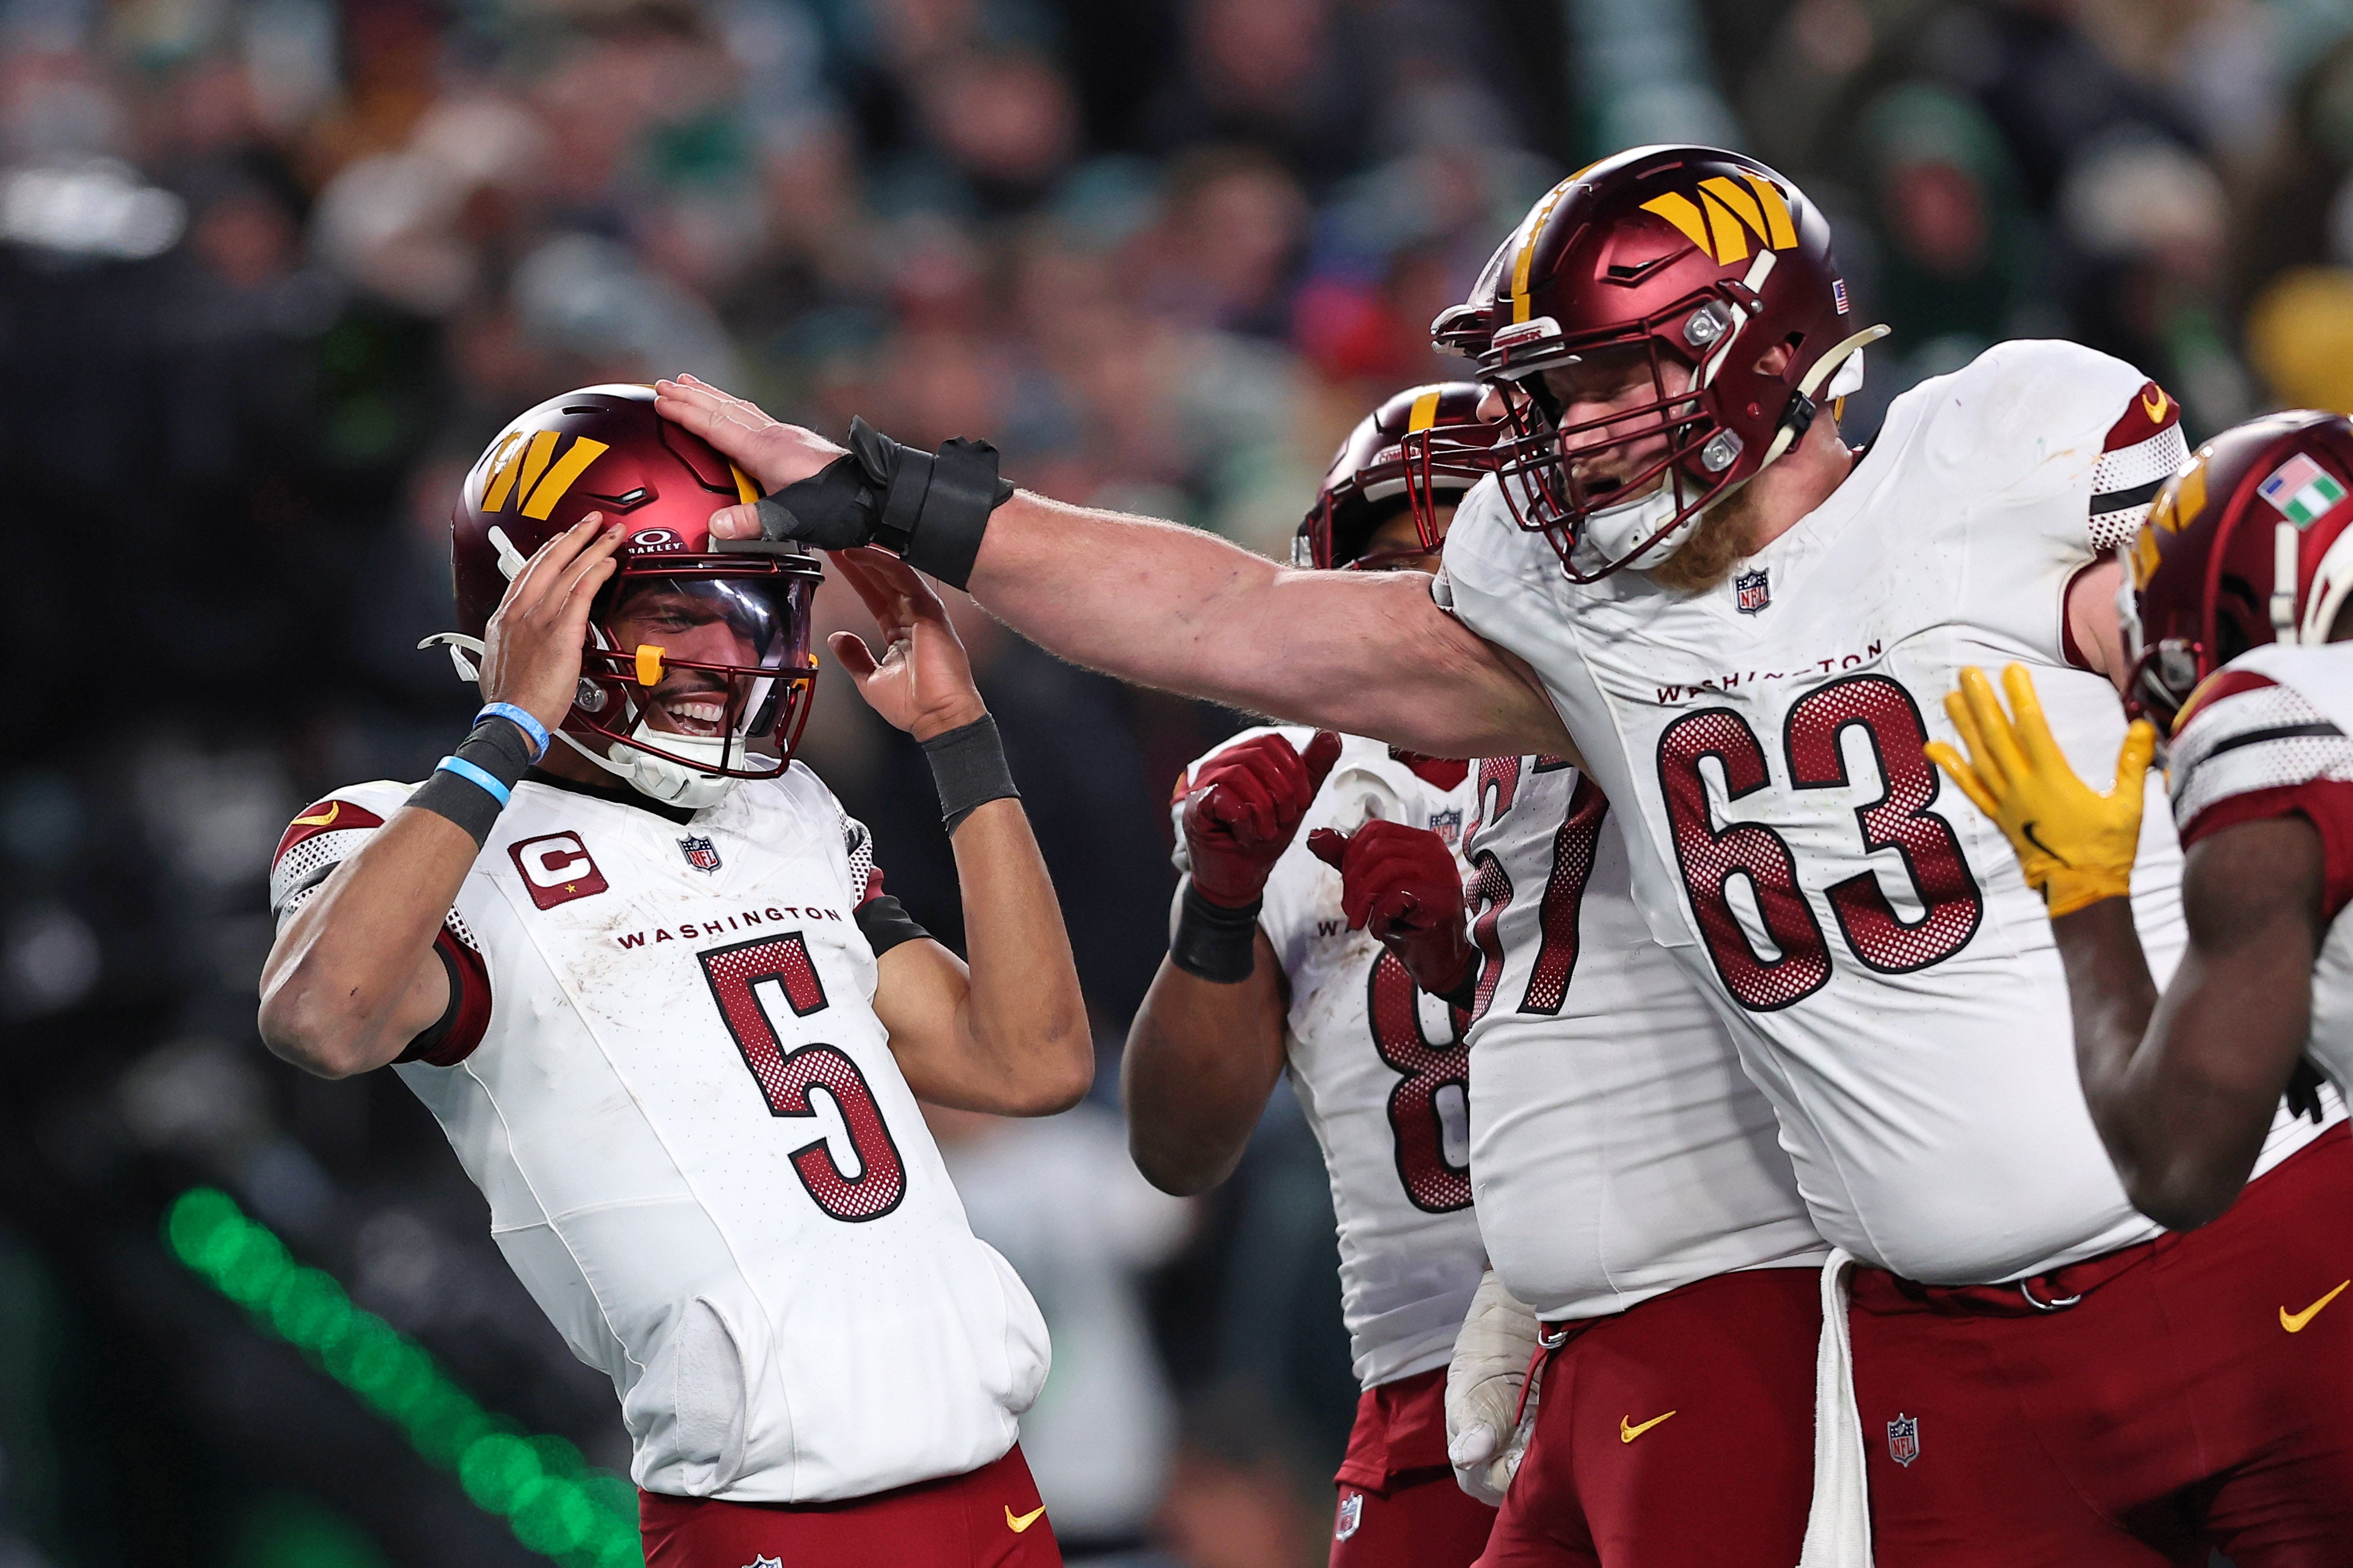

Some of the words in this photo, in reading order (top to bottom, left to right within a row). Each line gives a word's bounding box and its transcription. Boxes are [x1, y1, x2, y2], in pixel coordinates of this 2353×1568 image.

[628, 542, 681, 554] OAKLEY
[1740, 585, 1767, 608] NFL
[520, 836, 592, 887] C
[1657, 673, 1984, 1012] 63
[617, 907, 843, 950] WASHINGTON
[696, 931, 907, 1223] 5
[1367, 946, 1476, 1214] 8
